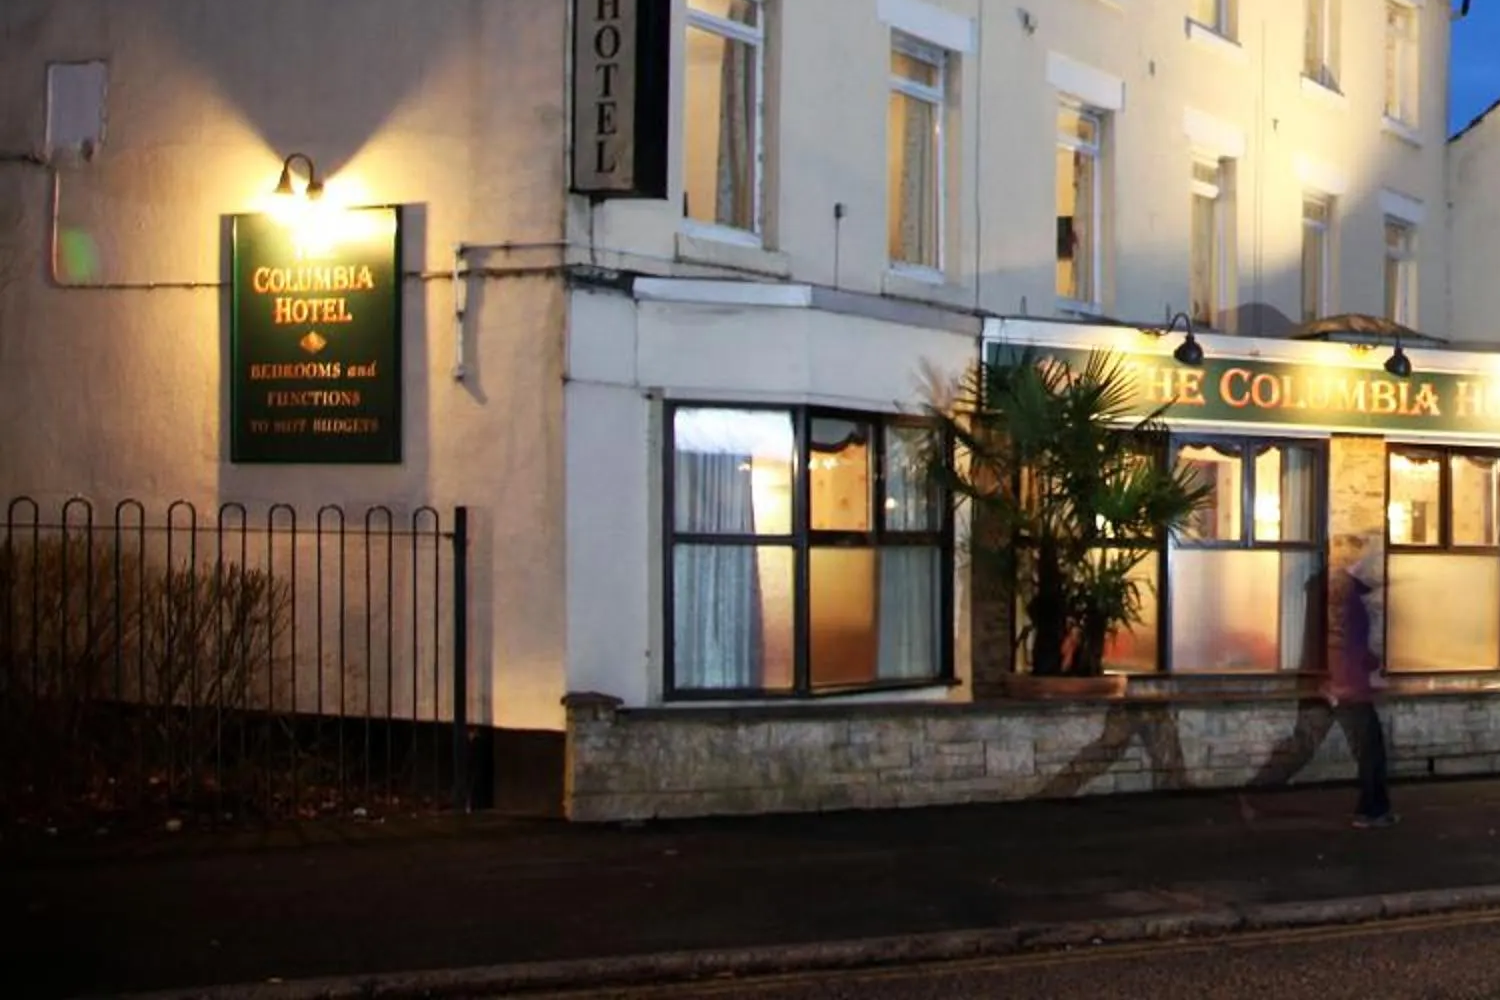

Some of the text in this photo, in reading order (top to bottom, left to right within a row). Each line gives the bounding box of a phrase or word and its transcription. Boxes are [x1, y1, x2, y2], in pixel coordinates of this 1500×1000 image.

[253, 264, 375, 293] COLUMBIA
[274, 297, 353, 324] HOTEL
[250, 360, 377, 380] BEDROOMS and
[266, 390, 361, 407] FUNCTIONS
[1118, 359, 1205, 405] HE
[1219, 367, 1440, 416] COLUMBIA
[313, 418, 379, 433] BUDGETS
